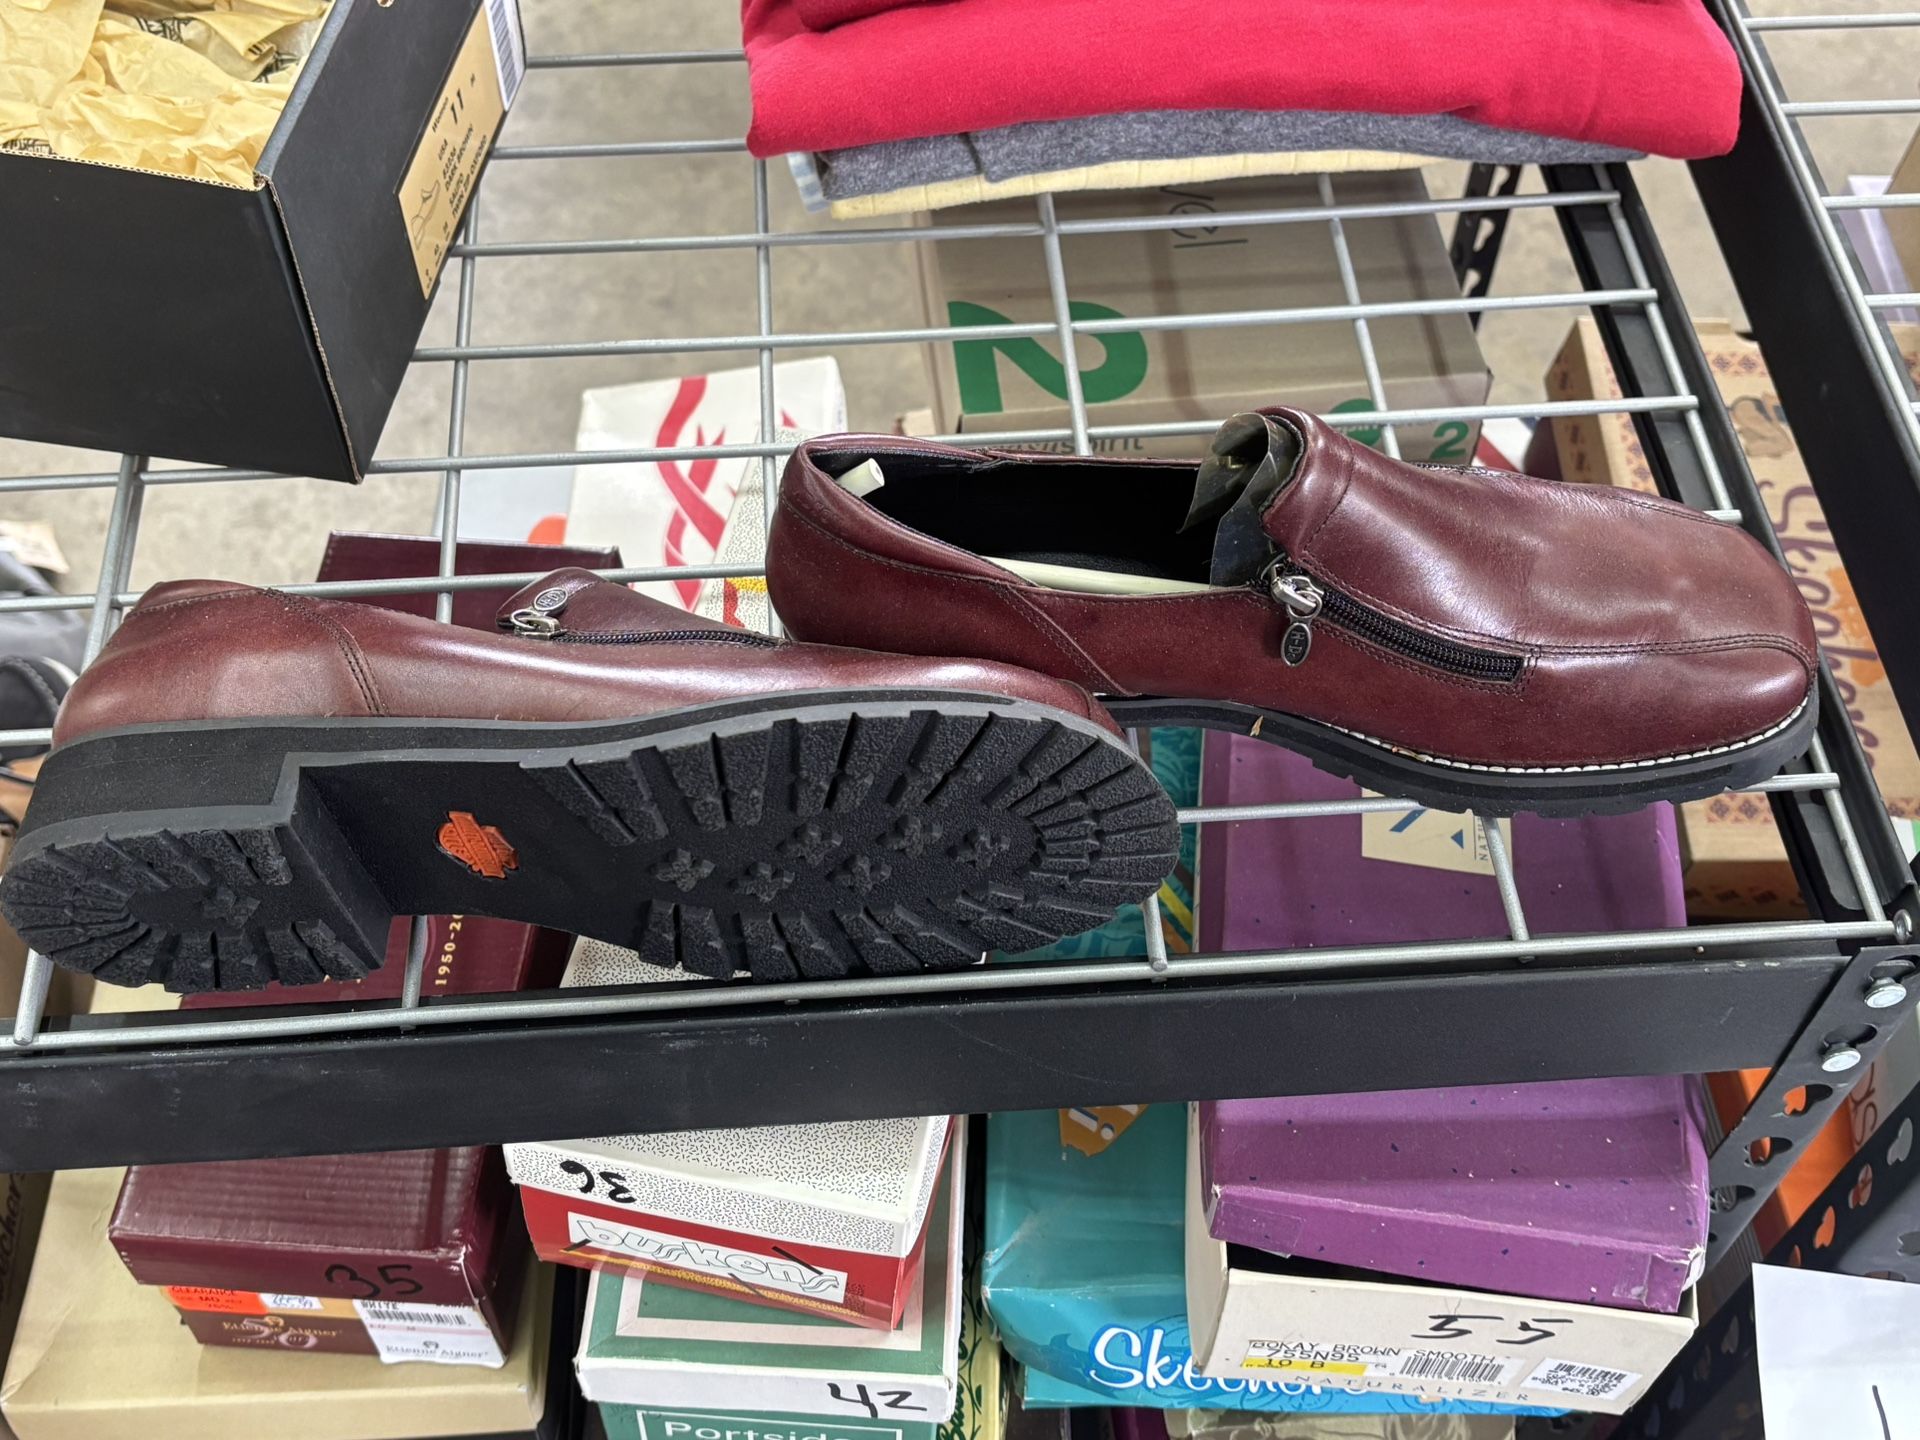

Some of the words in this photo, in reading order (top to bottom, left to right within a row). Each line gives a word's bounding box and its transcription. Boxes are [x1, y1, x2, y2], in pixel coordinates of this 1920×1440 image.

[451, 88, 464, 125] 11
[445, 162, 458, 192] DARK
[457, 124, 473, 164] BROWN
[1430, 420, 1469, 461] 2
[560, 1160, 636, 1203] 36
[577, 1219, 840, 1293] buskens
[325, 1263, 423, 1299] 35
[361, 1300, 399, 1310] WHITE
[1252, 1342, 1319, 1350] BOKAY
[1333, 1343, 1402, 1356] BROWN
[1414, 1349, 1496, 1363] SMOOTH
[1266, 1359, 1293, 1367] 10
[1310, 1361, 1325, 1369] B
[827, 1383, 928, 1419] 42
[1294, 1375, 1529, 1401] NATURALIZER
[664, 1421, 855, 1440] Portsi
